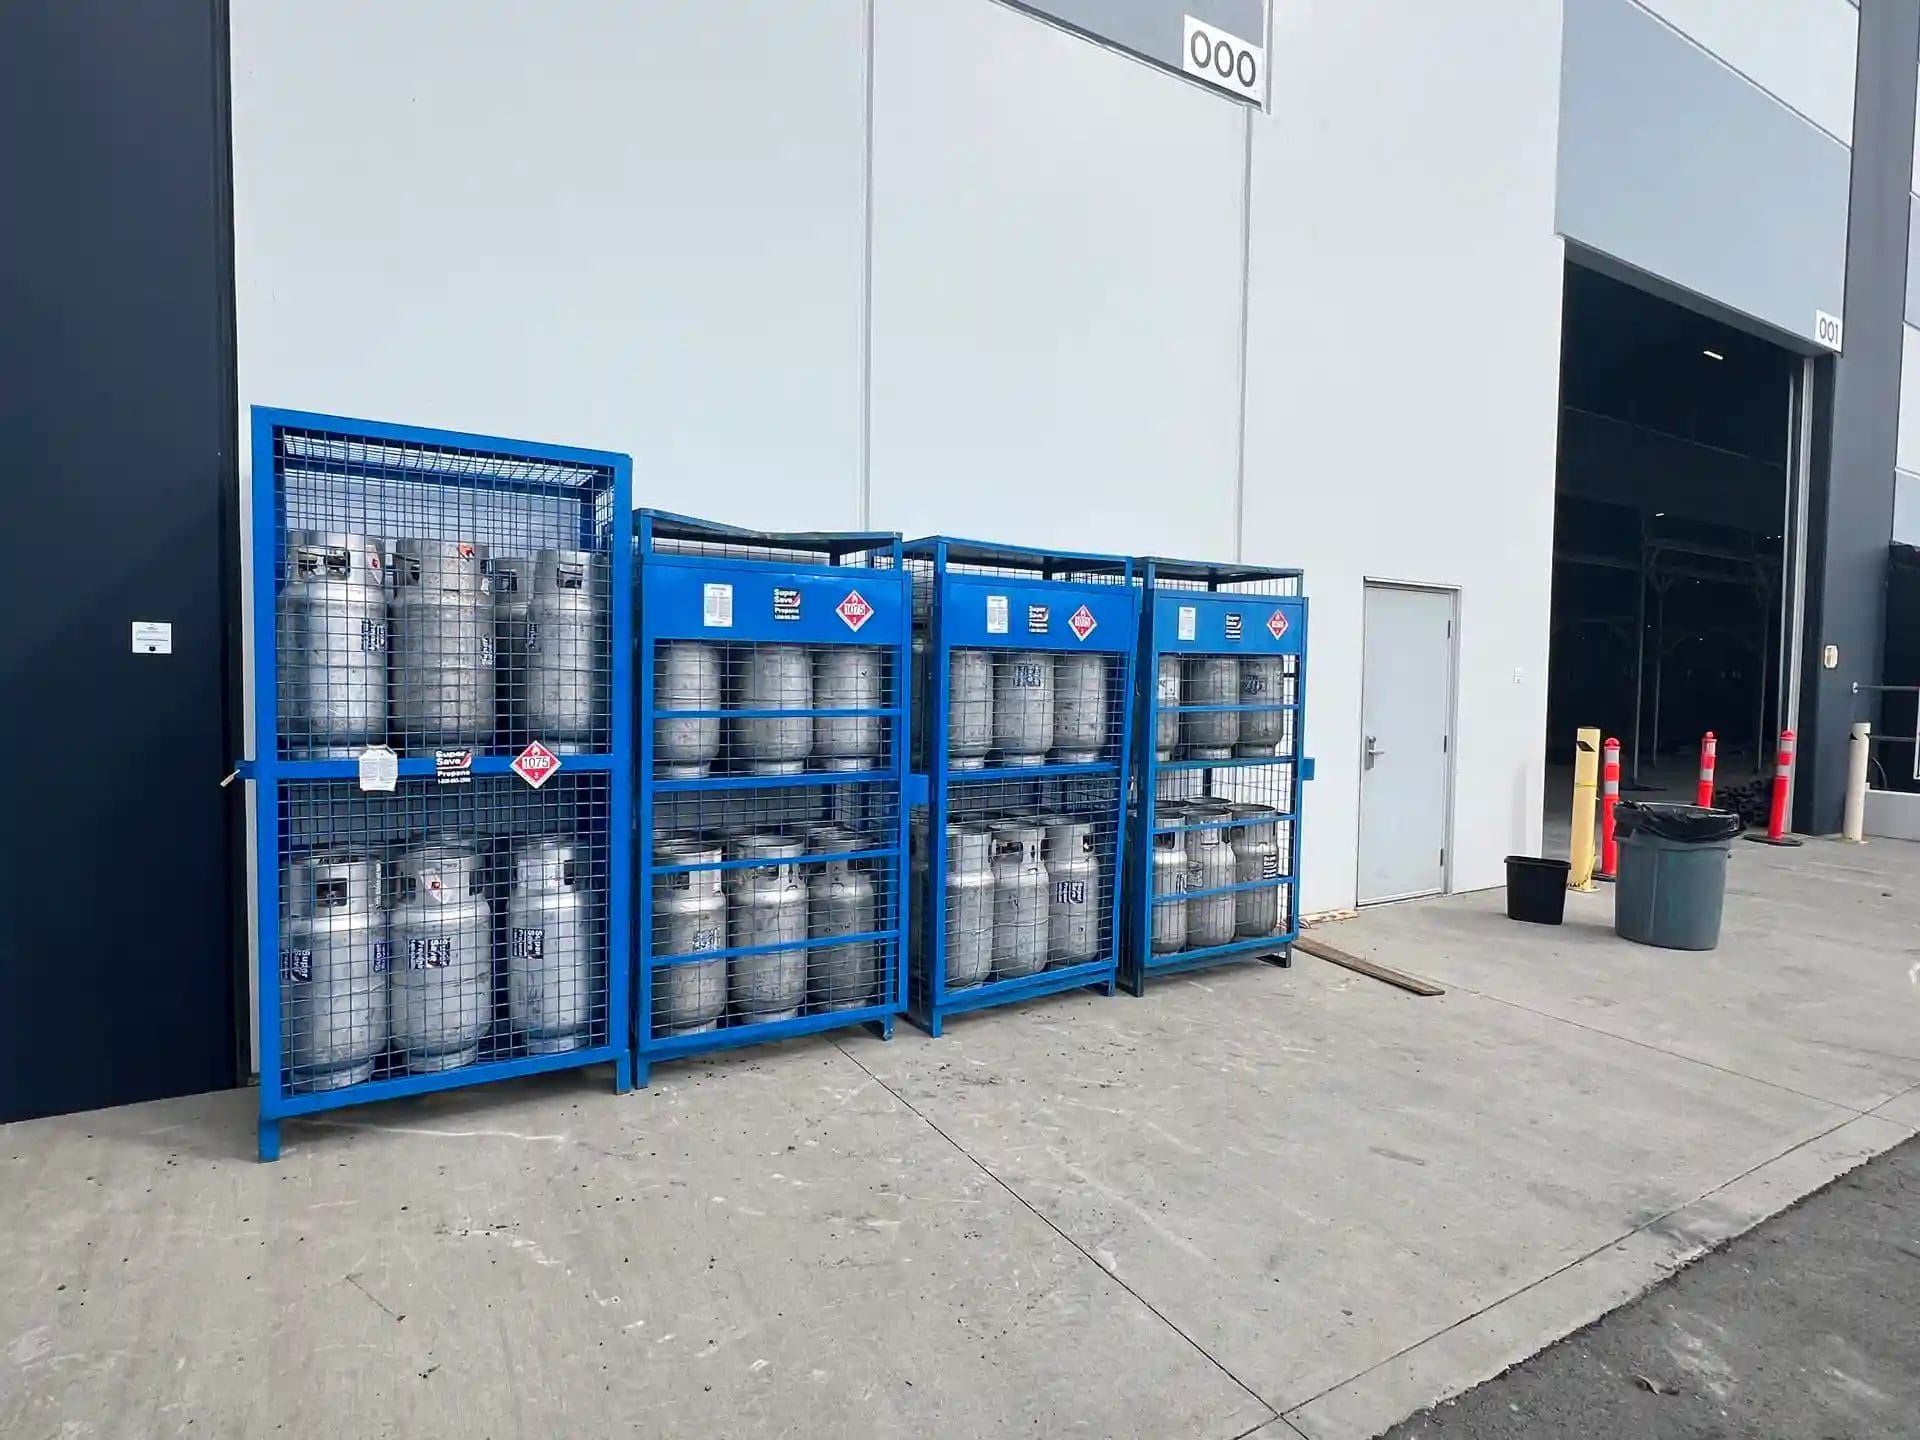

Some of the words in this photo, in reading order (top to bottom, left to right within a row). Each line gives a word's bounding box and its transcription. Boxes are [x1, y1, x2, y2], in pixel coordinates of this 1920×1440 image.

[1190, 30, 1256, 88] 000
[1819, 317, 1839, 345] 001
[435, 758, 462, 766] Save
[523, 757, 550, 769] 1075
